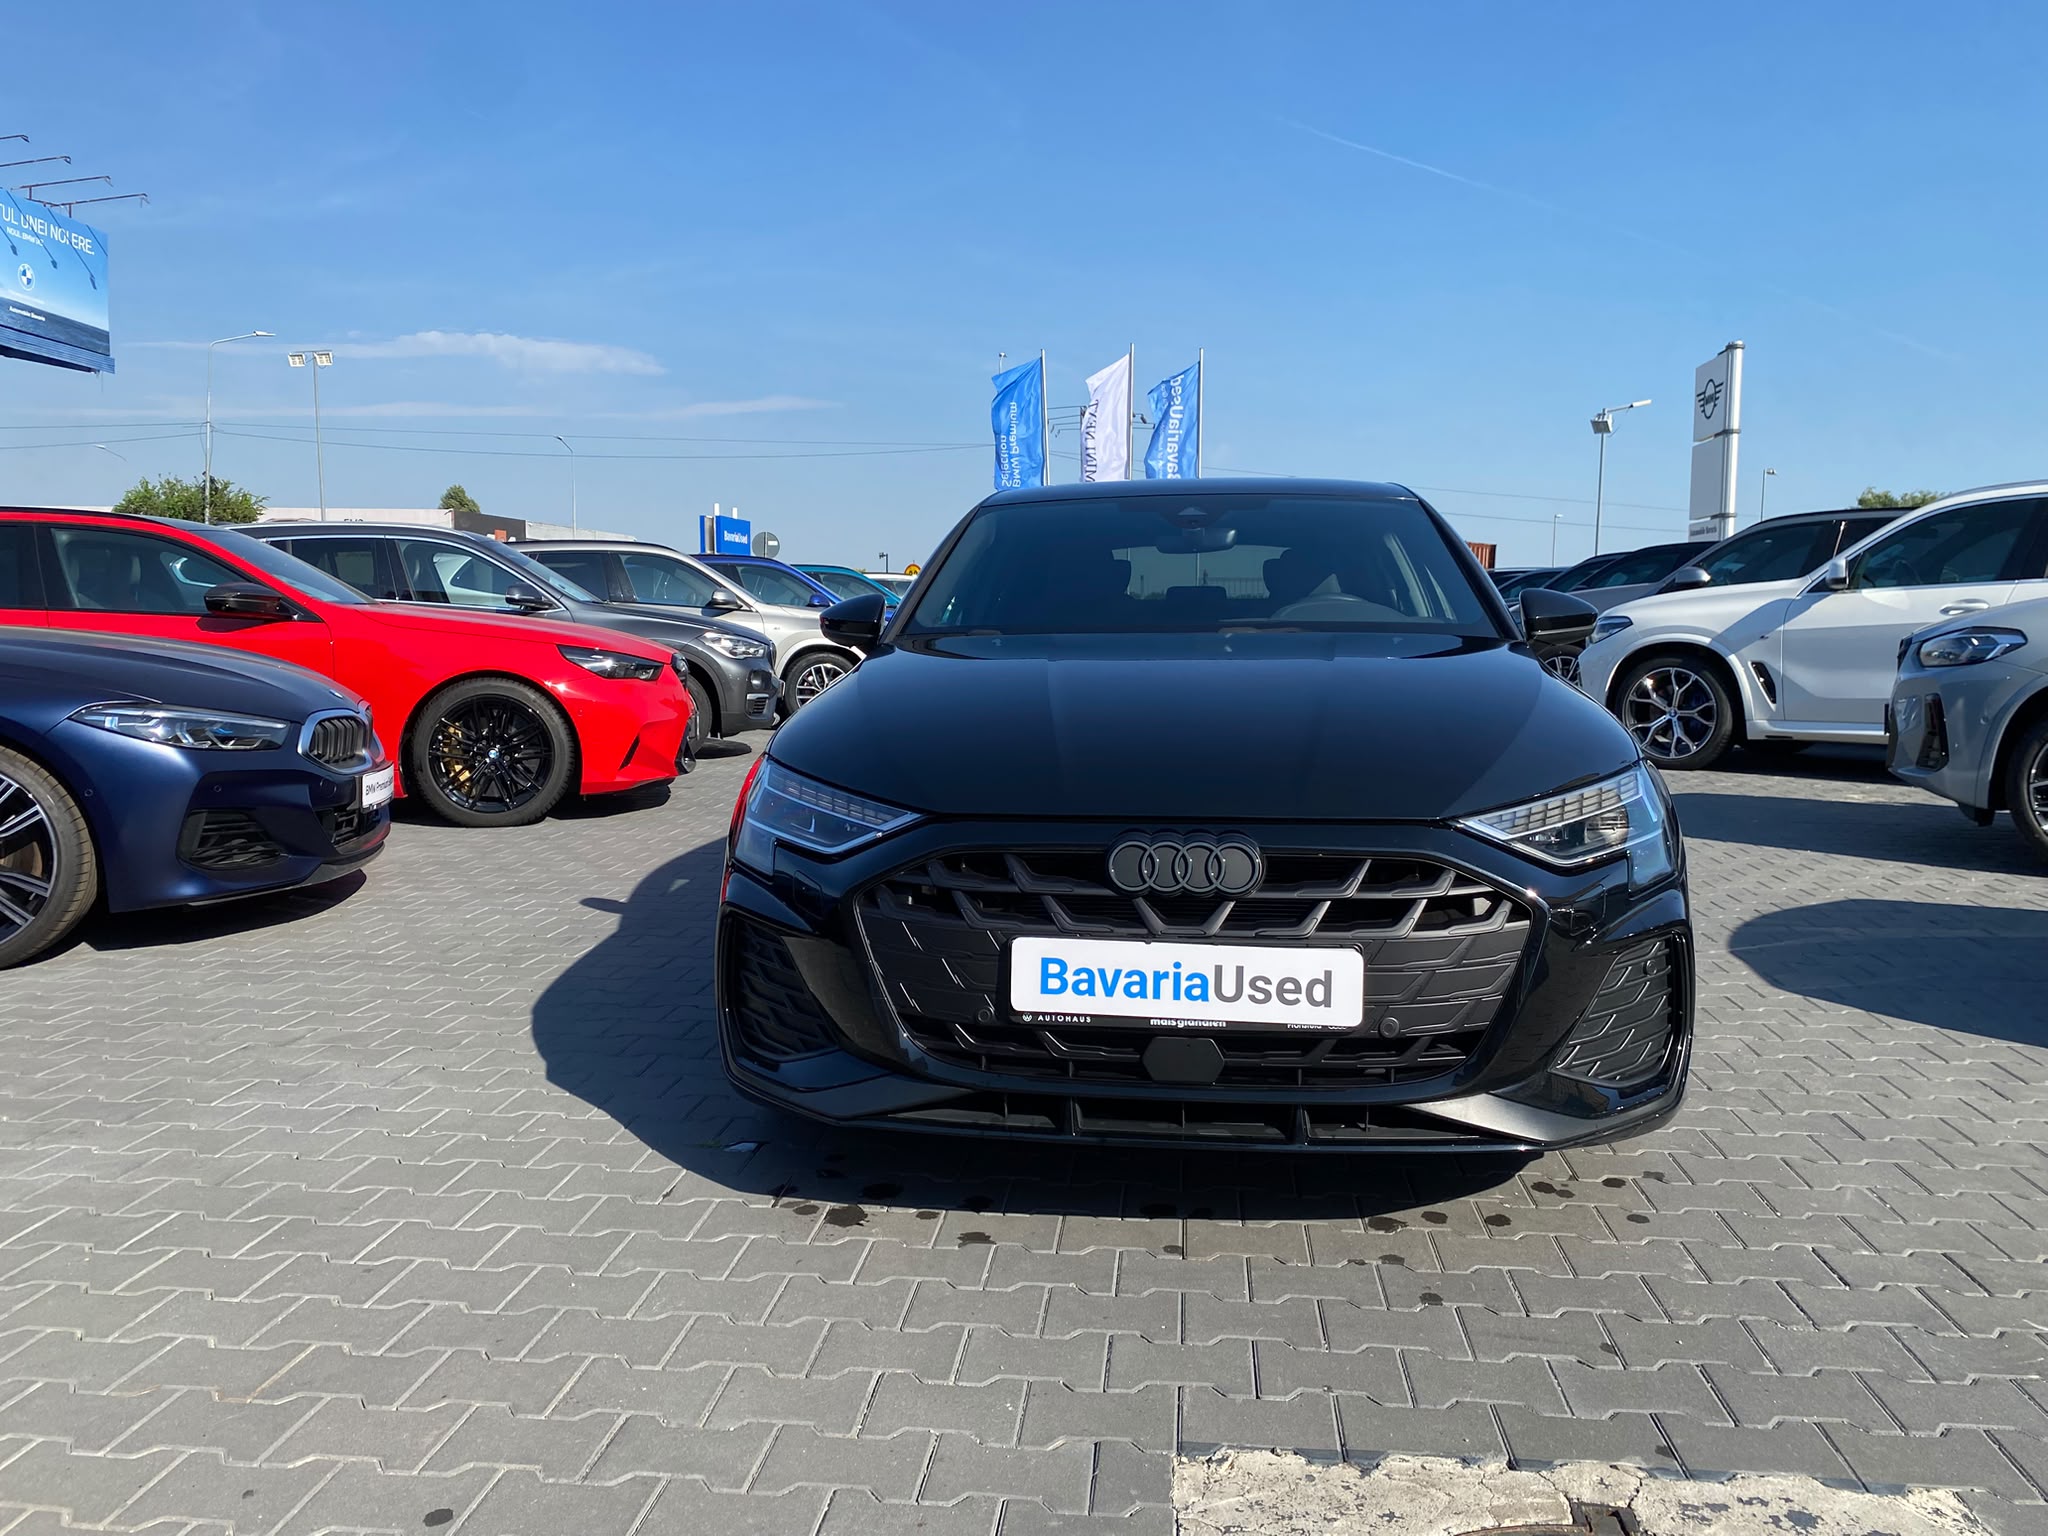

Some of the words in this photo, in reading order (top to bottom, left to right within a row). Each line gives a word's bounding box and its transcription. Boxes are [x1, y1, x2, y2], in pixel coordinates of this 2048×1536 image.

[21, 213, 48, 236] UNEI
[50, 224, 69, 245] NOI
[71, 233, 95, 255] ERE.
[724, 530, 748, 545] BavariaUsed
[1039, 956, 1333, 1008] BavariaUsed
[1037, 1014, 1091, 1023] AUTOHAUS
